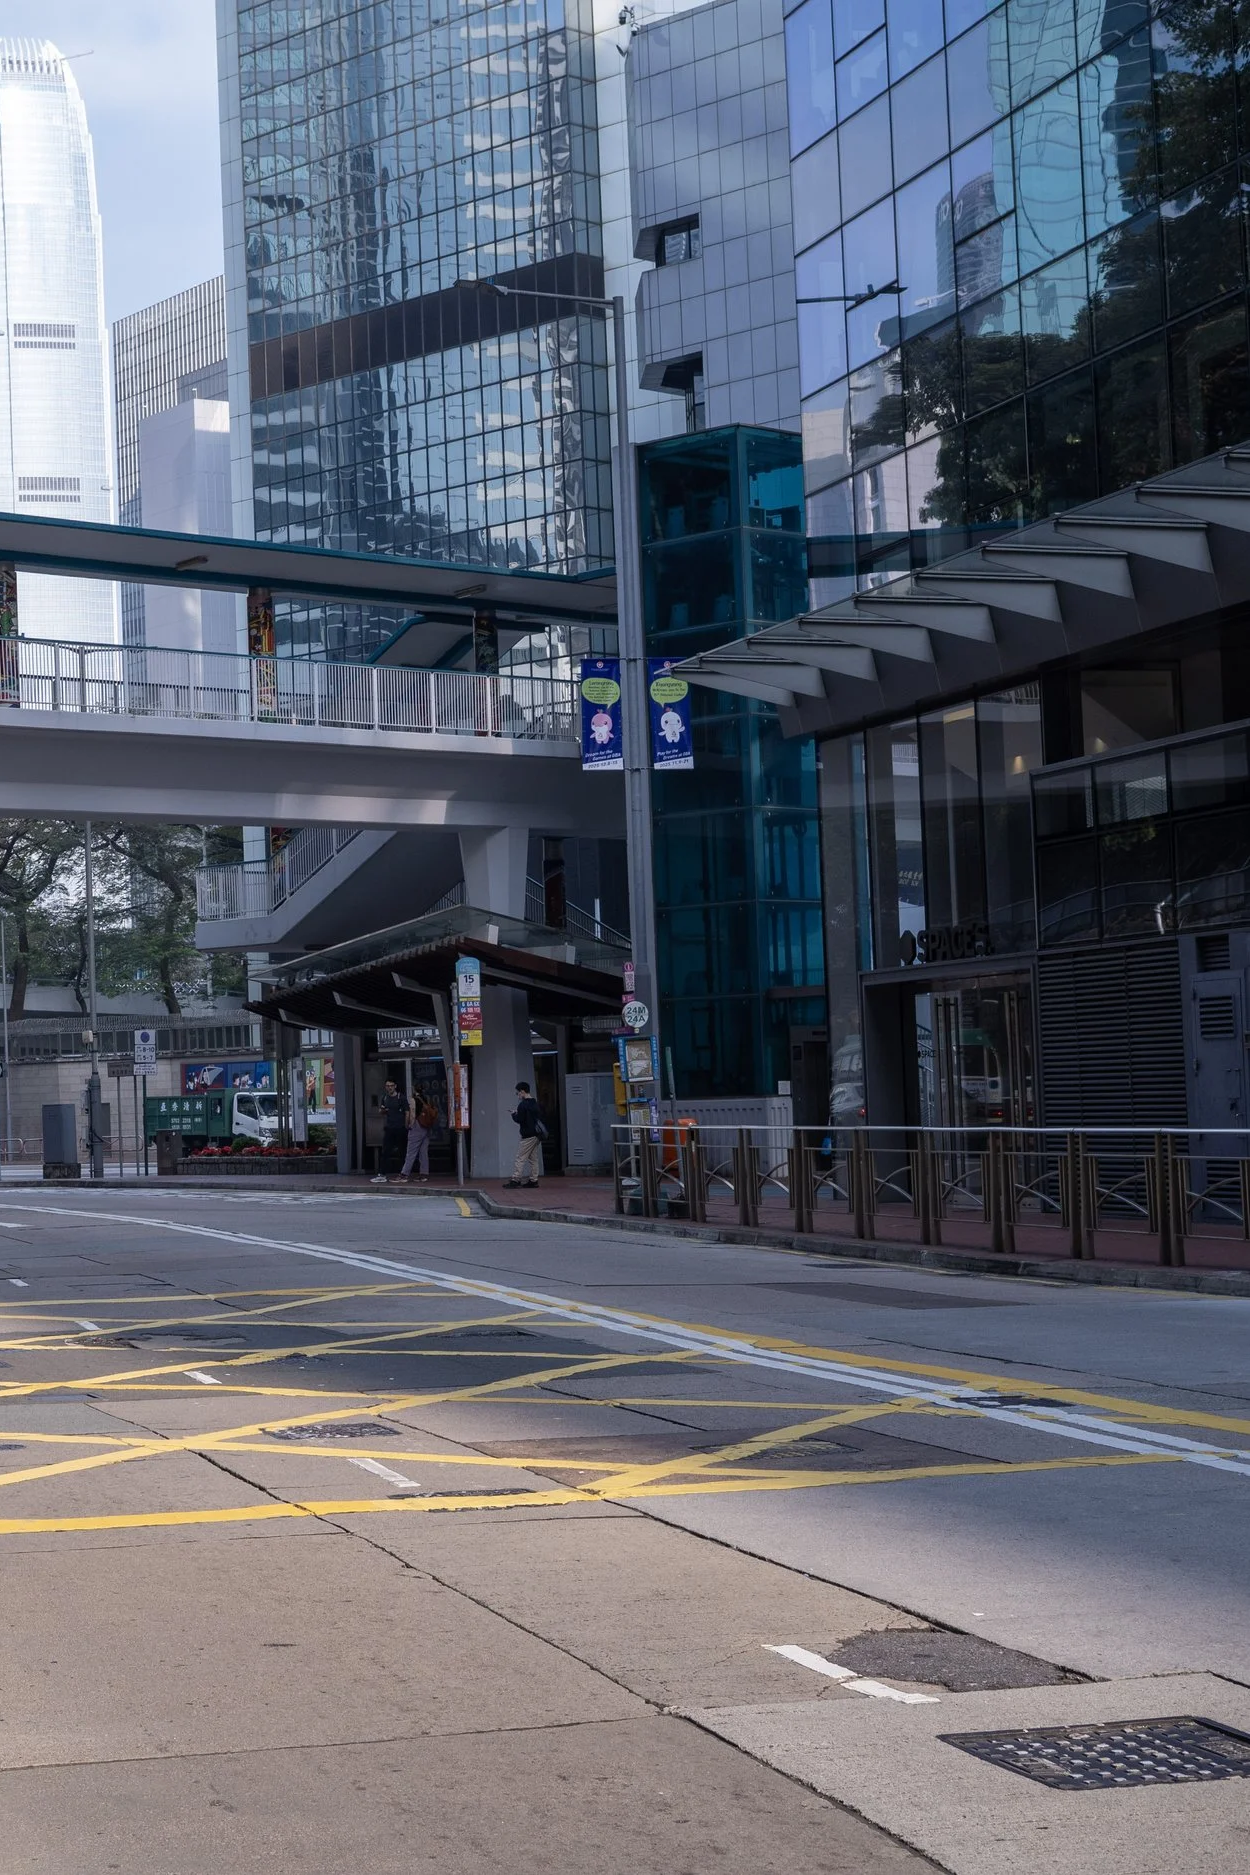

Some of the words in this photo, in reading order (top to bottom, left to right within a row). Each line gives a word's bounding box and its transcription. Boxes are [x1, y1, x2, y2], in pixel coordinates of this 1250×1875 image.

[463, 974, 475, 984] 15
[627, 1006, 646, 1014] 24M
[627, 1015, 646, 1023] 24A
